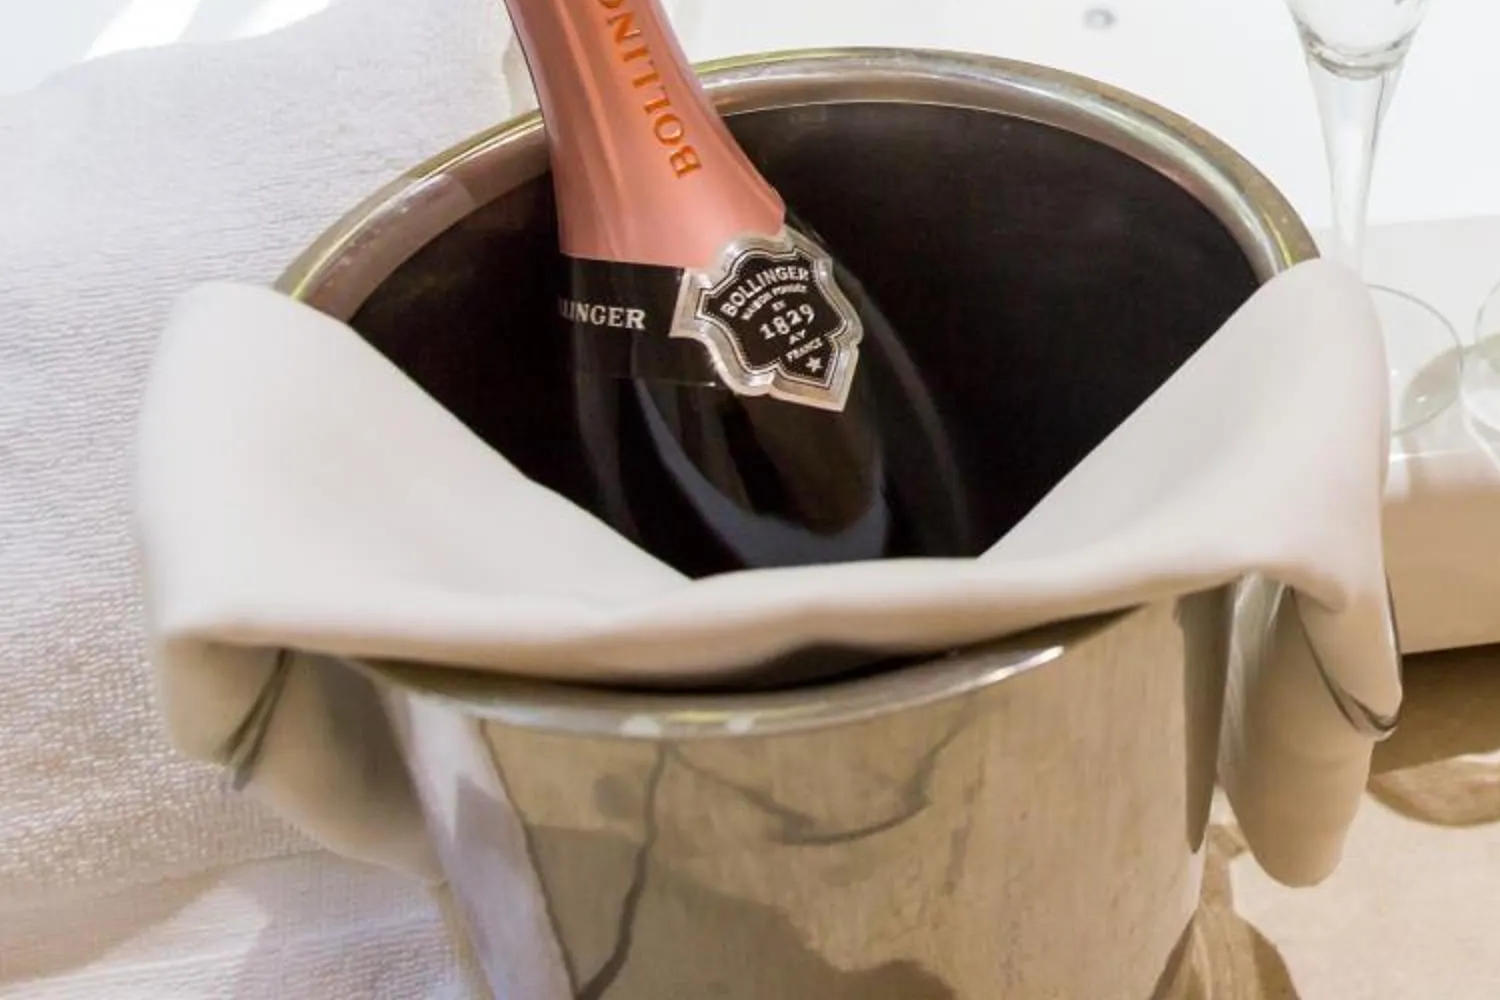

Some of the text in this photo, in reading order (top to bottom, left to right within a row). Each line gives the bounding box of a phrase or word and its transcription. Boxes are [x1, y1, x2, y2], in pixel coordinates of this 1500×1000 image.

[720, 266, 809, 317] BOLLINGER
[760, 304, 815, 340] 1829
[785, 337, 823, 362] FRANCE
